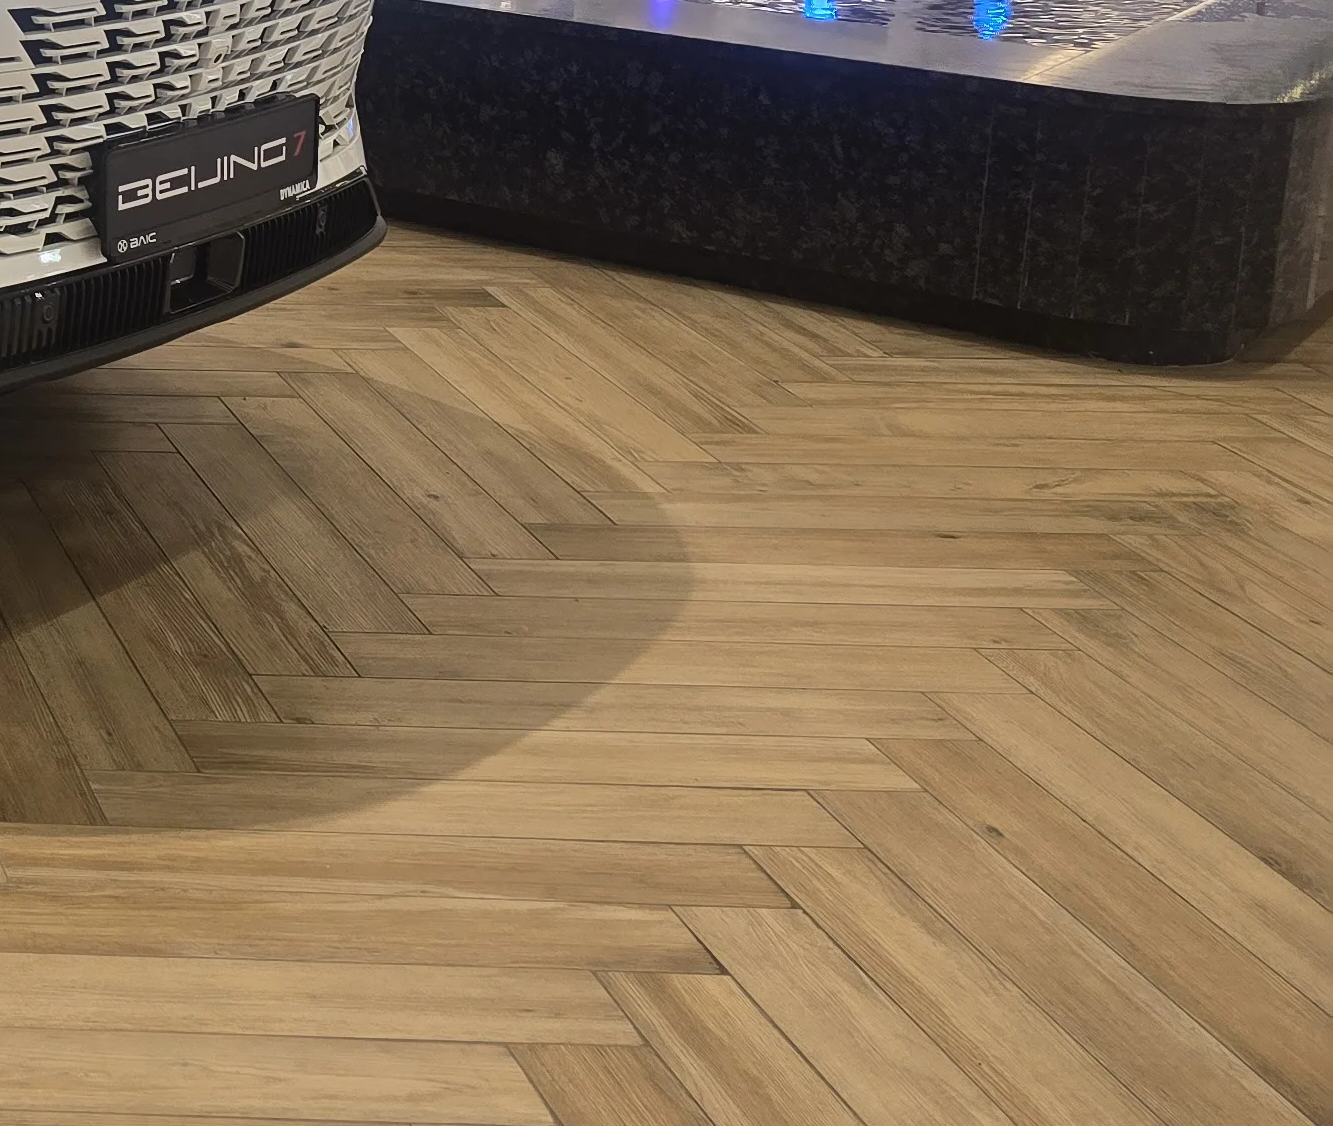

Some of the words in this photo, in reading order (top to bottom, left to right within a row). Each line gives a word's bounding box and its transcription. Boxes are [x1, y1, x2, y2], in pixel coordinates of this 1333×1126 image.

[118, 137, 287, 211] BEIJING
[293, 130, 307, 157] 7
[129, 232, 157, 249] BAIC
